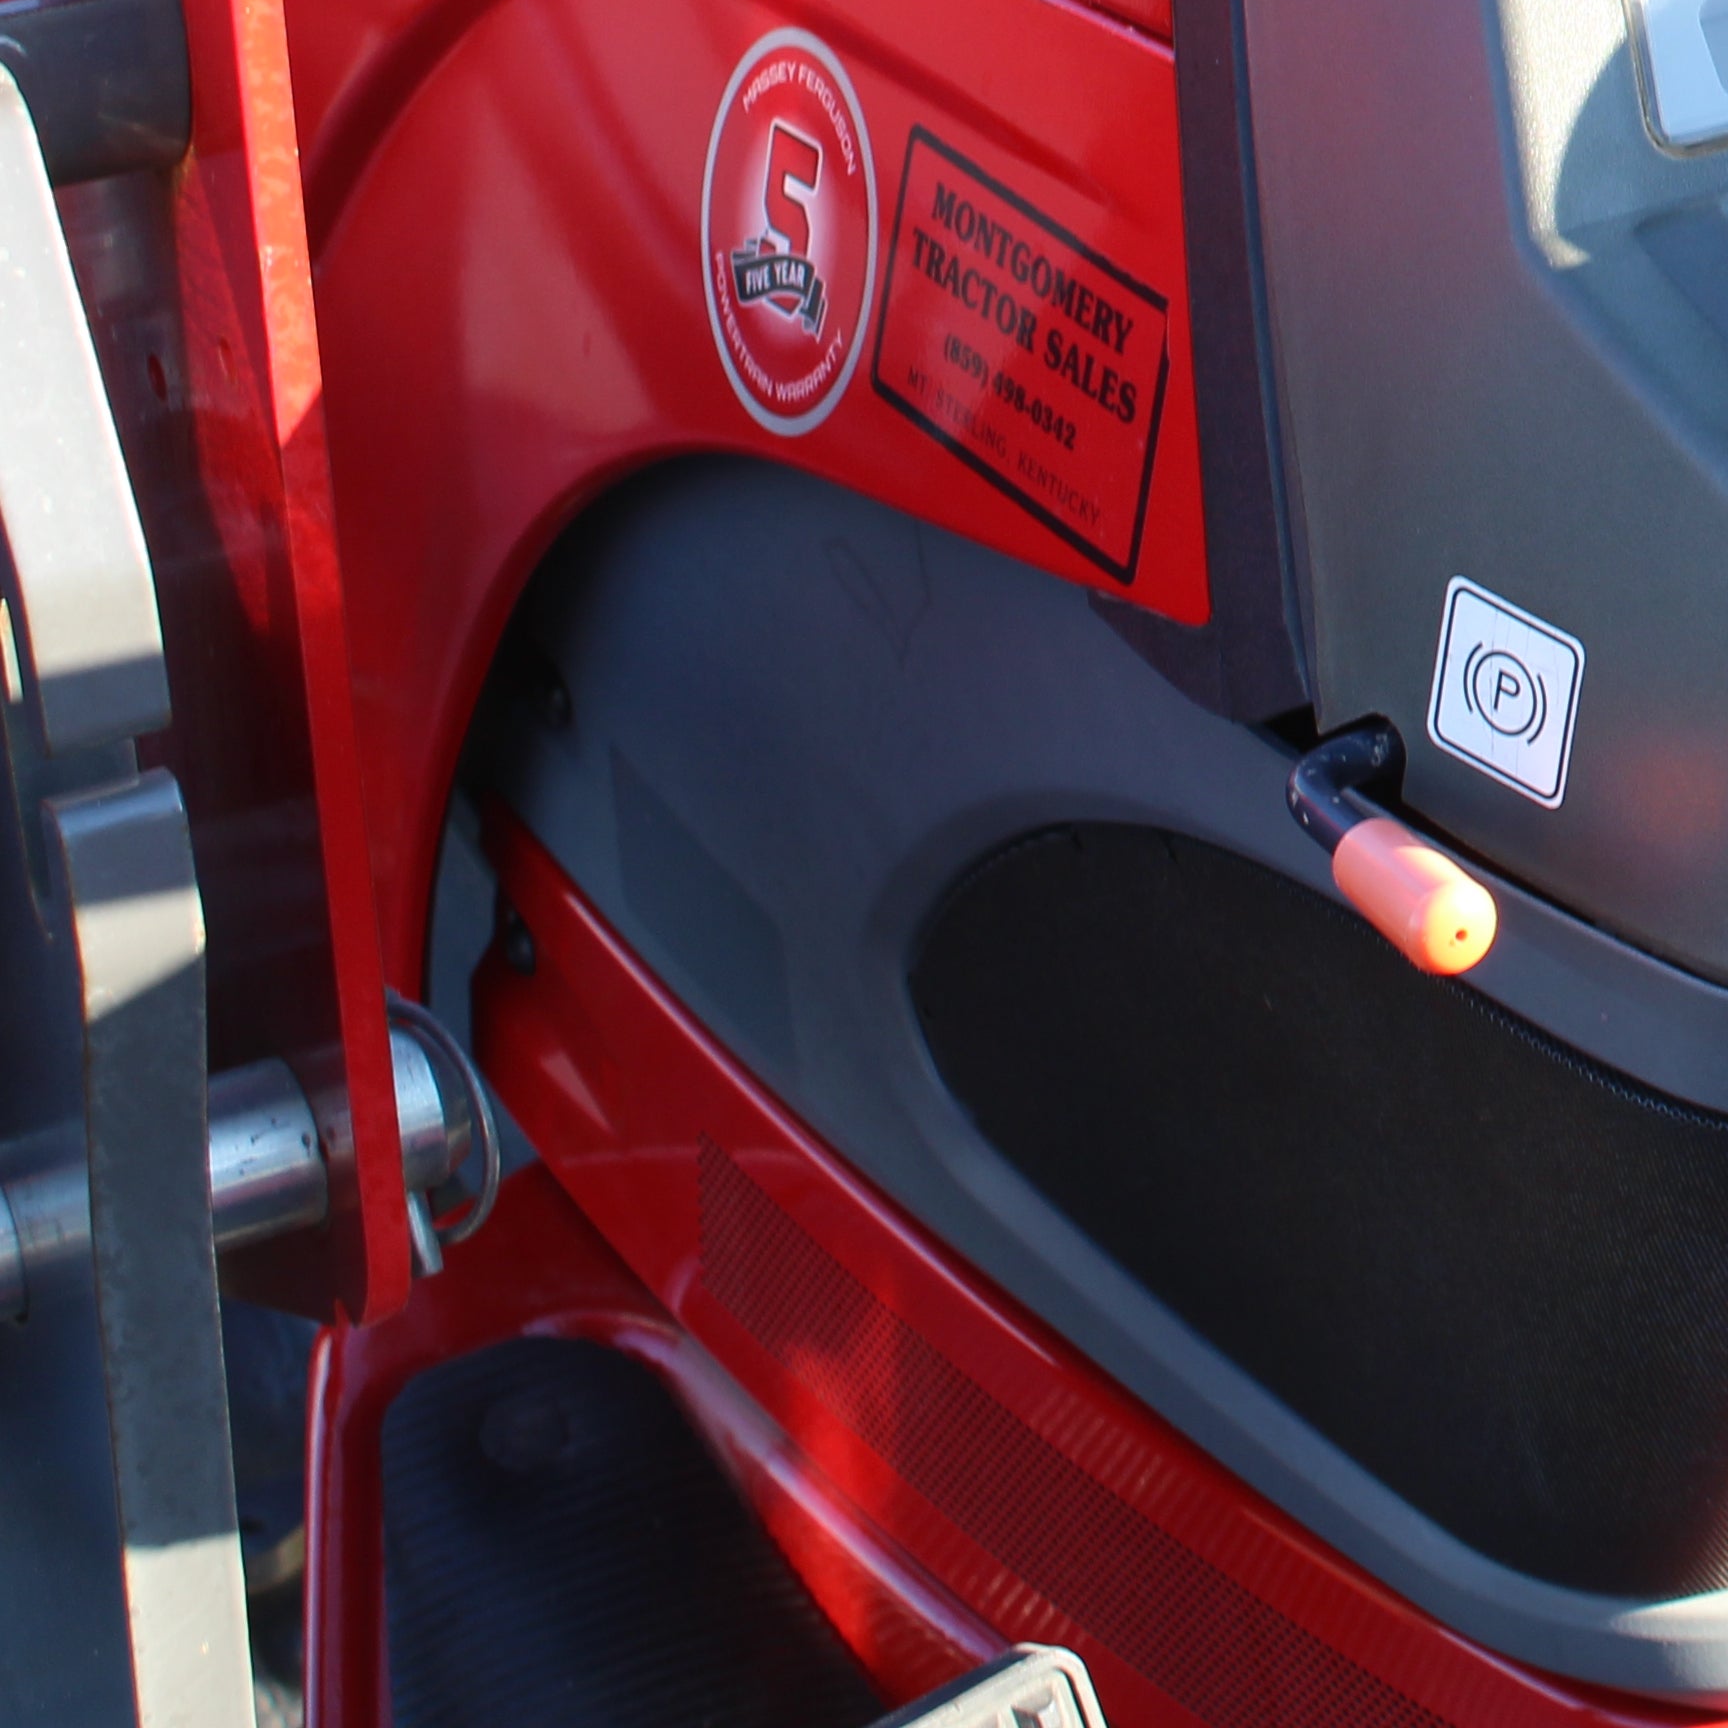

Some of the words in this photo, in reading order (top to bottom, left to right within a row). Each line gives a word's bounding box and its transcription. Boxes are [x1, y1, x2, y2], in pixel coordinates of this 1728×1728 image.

[741, 60, 797, 115] MASSEY
[798, 63, 857, 177] FERGUSON
[744, 266, 771, 296] FIVE
[773, 260, 807, 288] YEAR
[912, 228, 1038, 354] TRACTOR
[1045, 328, 1139, 425] SALES
[931, 181, 1135, 356] MONTGOMERY
[715, 251, 773, 397] POWERTRAIN
[775, 327, 844, 404] WARRANTY
[1017, 451, 1102, 527] KENTUCKY
[1494, 670, 1521, 710] P
